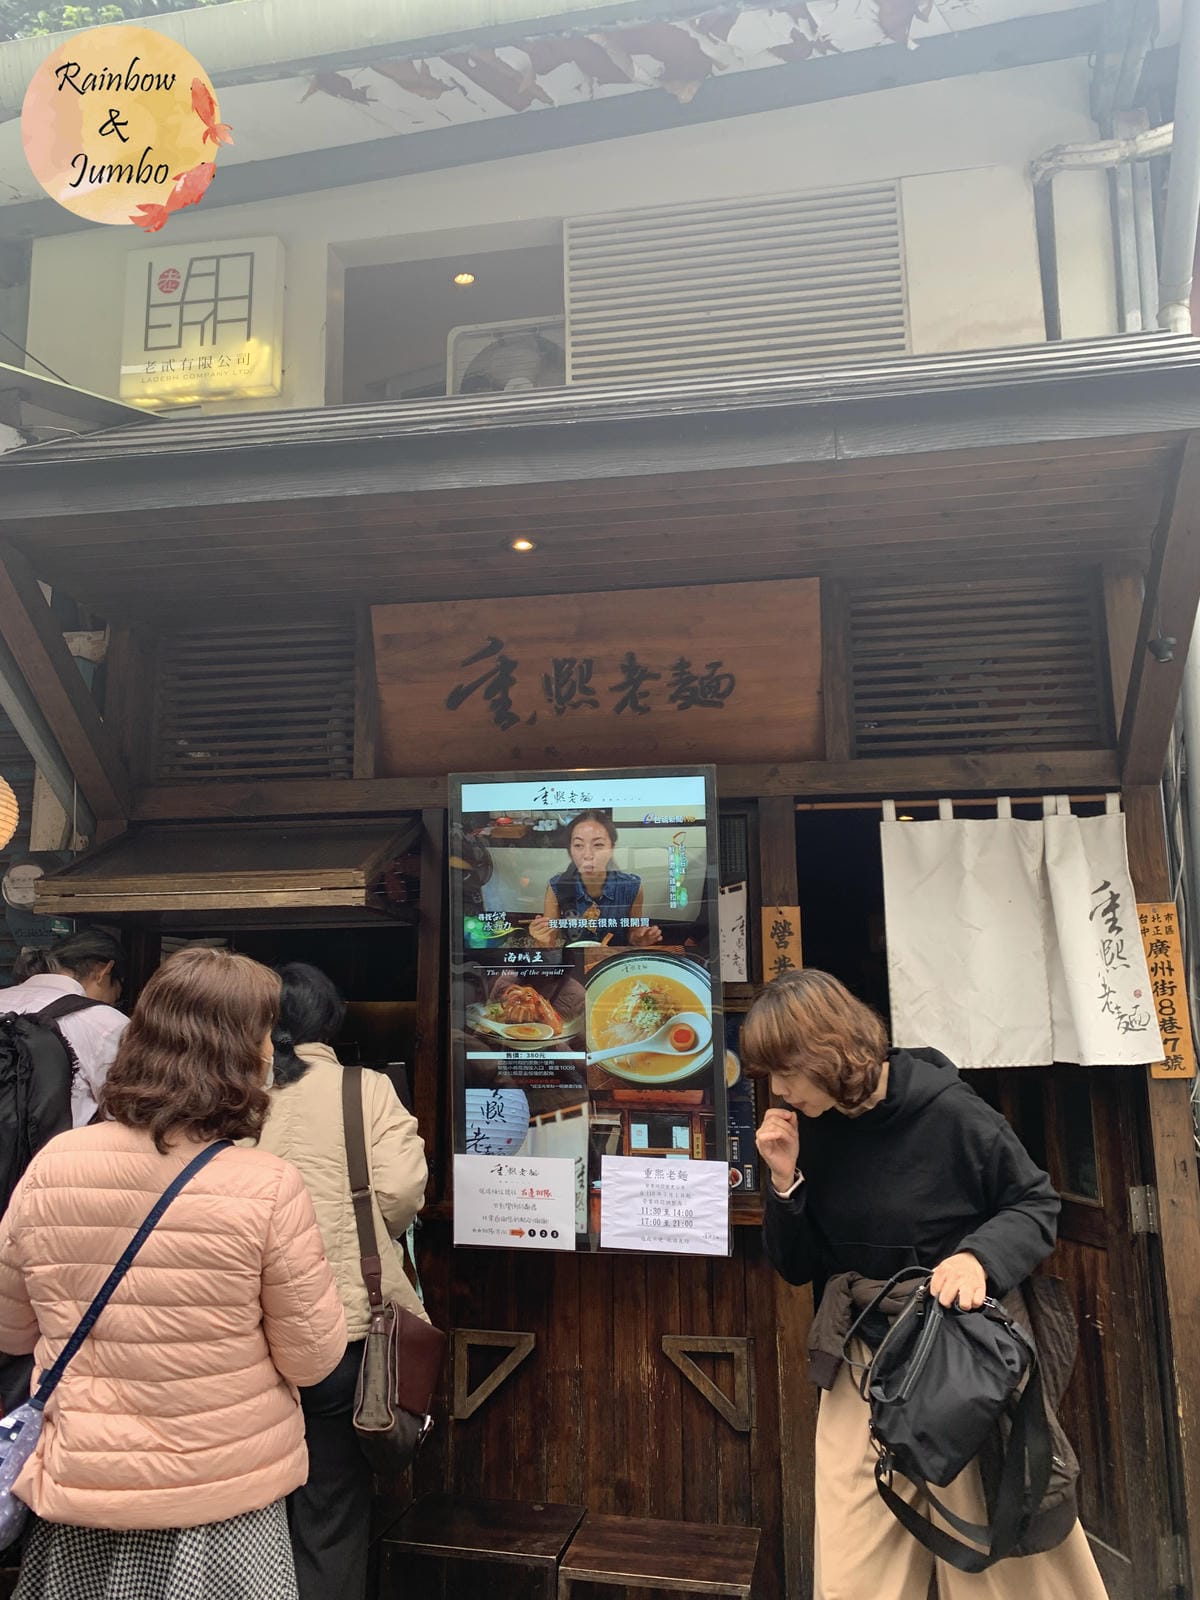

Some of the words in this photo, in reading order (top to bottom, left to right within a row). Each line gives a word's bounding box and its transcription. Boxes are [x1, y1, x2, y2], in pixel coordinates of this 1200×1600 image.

[445, 636, 736, 731] 重熙老麵
[548, 918, 617, 929] 我覺得現在很熱
[1139, 912, 1174, 926] 台北市
[1140, 925, 1175, 937] 中正區
[503, 951, 544, 963] 海賊王
[486, 969, 499, 977] The
[501, 969, 518, 978] King
[520, 969, 528, 977] of
[1147, 938, 1186, 1072] 廣州街8巷7號
[644, 1167, 689, 1181] 重熙老麵
[641, 1206, 661, 1216] 11:30
[673, 1208, 694, 1218] 14:00
[641, 1217, 661, 1227] 17:00
[673, 1219, 694, 1228] 21:00
